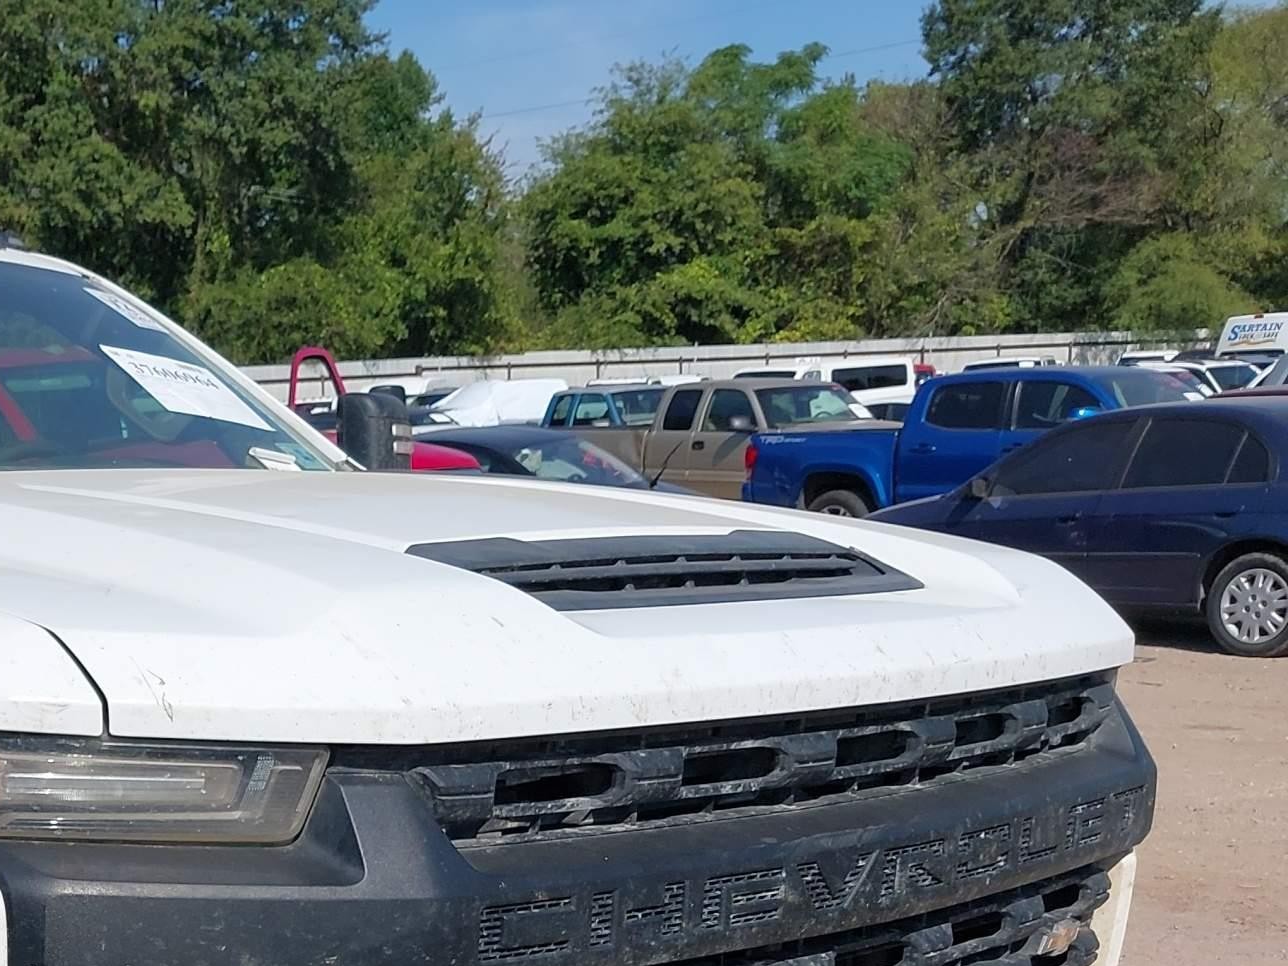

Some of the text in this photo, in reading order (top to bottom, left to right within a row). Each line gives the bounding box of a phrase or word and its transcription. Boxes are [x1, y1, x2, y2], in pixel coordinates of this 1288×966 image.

[1228, 322, 1283, 341] SARTAIN
[128, 361, 219, 390] 37606964
[477, 783, 1147, 962] CHEVROLET
